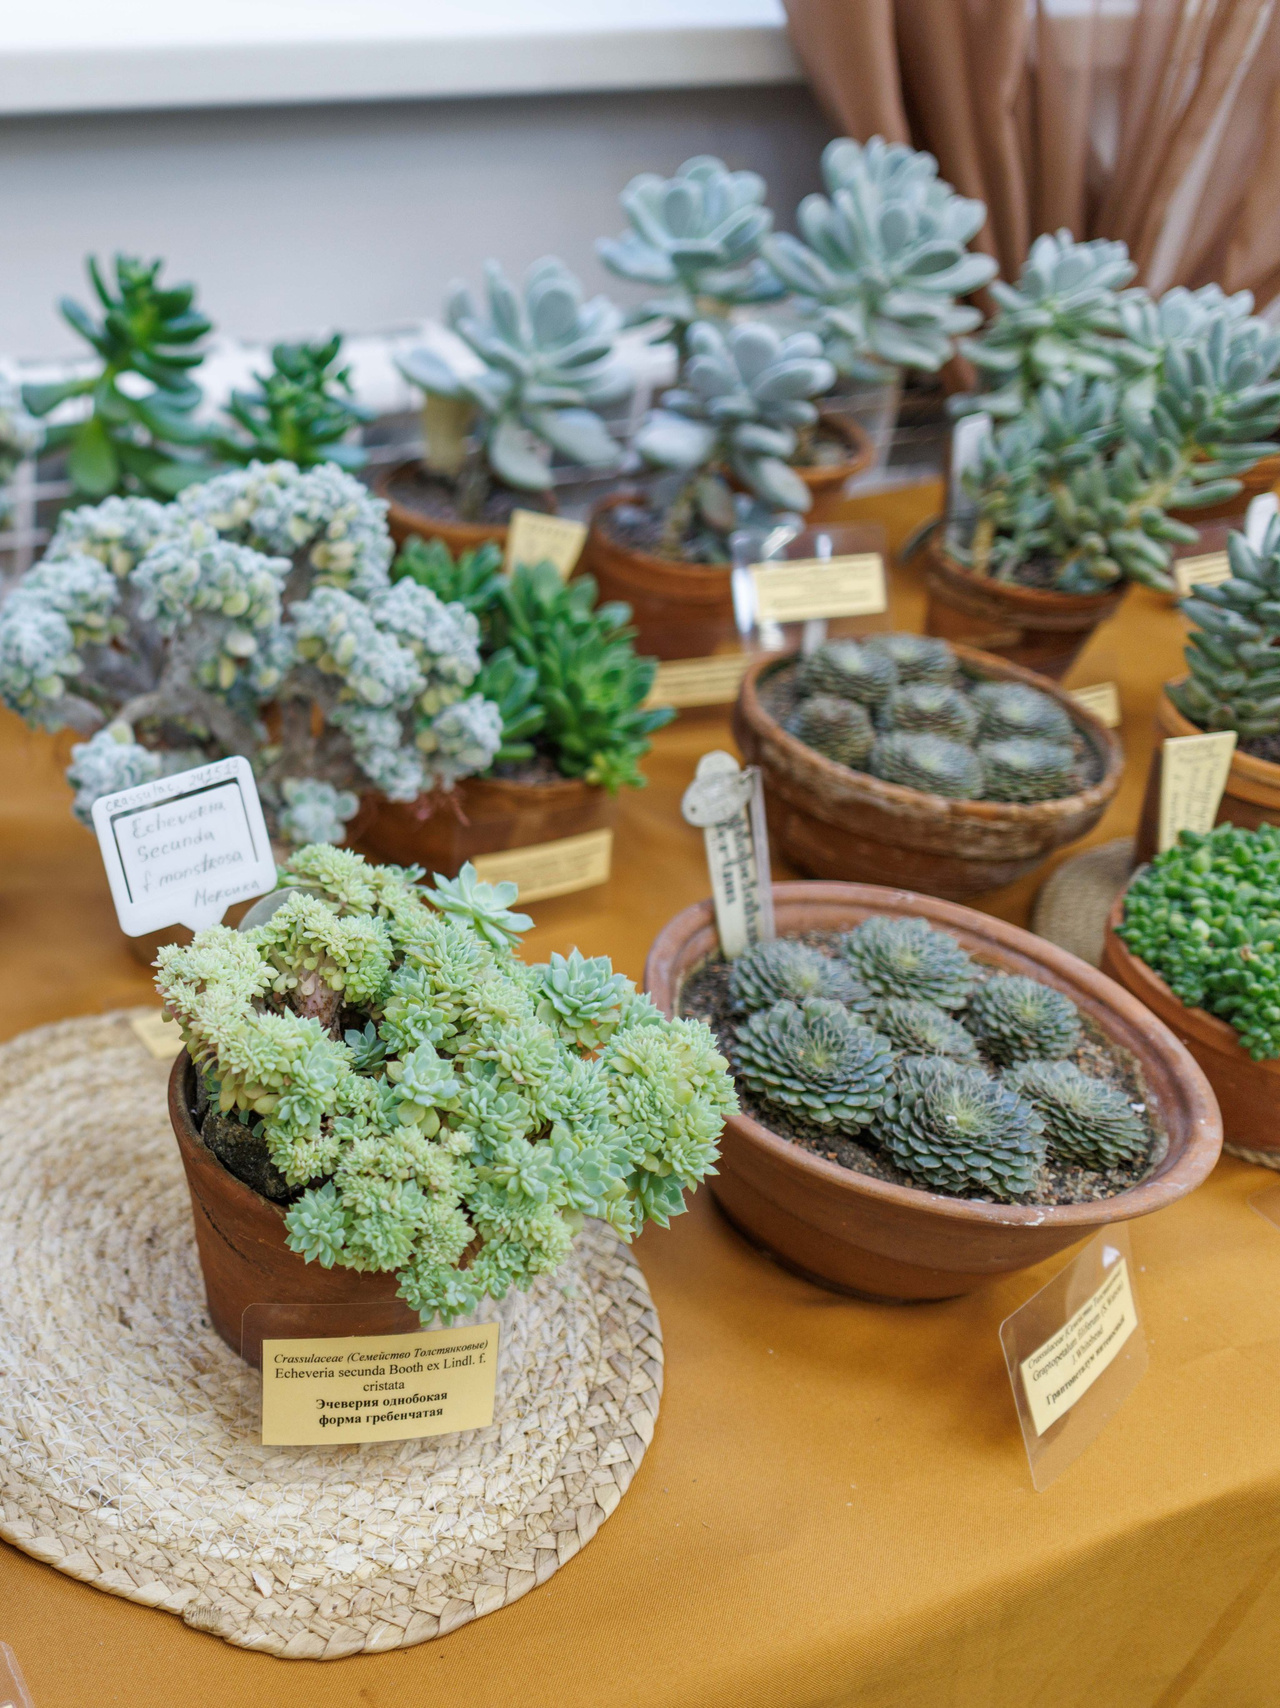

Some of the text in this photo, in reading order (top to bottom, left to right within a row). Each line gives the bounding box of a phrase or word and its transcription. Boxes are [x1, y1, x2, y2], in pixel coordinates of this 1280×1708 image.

[274, 1339, 488, 1365] Crassulaceae (Семейство Толстянковые)
[275, 1352, 487, 1379] Echeveria secunda Booth ex Lindl. f.
[363, 1380, 405, 1392] cristata
[316, 1391, 448, 1411] Эчеверия однобокая
[319, 1408, 443, 1427] форма гребенчатая
